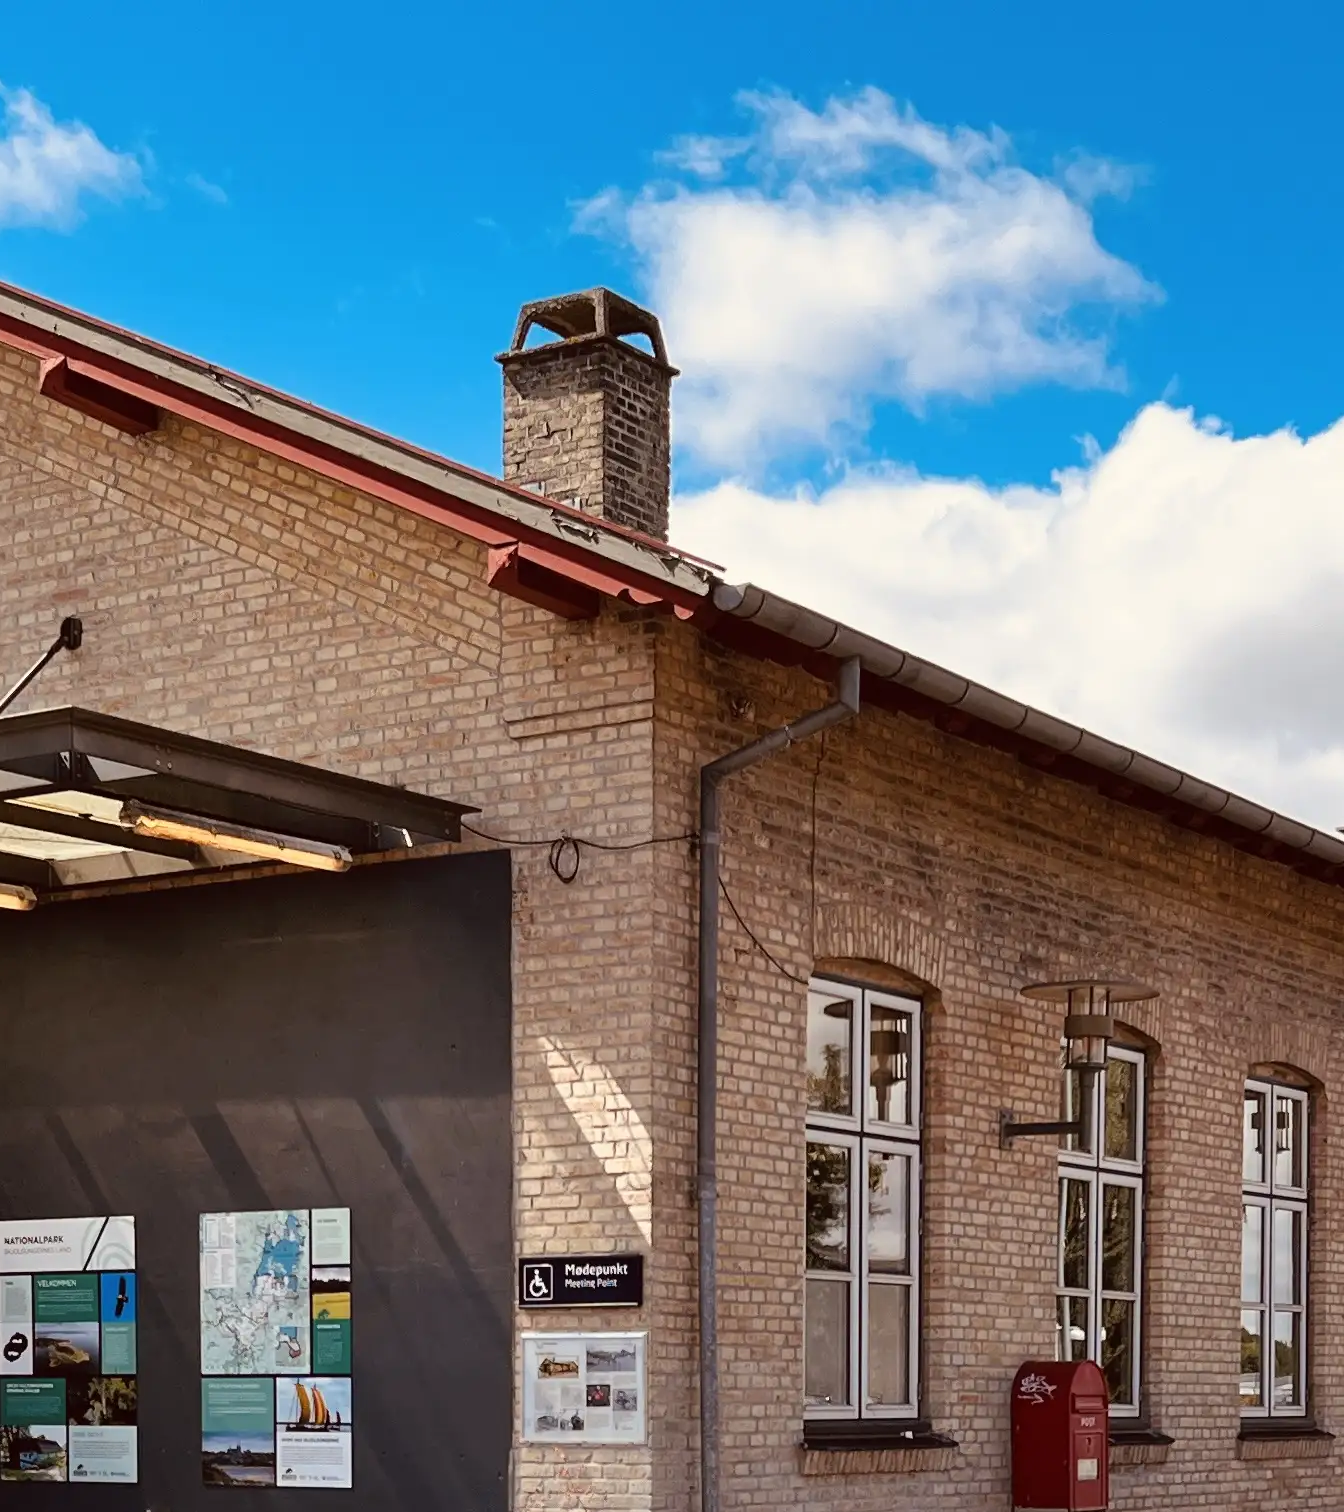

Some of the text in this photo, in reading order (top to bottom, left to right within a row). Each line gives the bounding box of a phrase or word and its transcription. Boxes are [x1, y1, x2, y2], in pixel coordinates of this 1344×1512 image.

[4, 1235, 64, 1246] NATIONALPARK
[564, 1262, 629, 1277] Mødepunkt
[37, 1279, 77, 1288] VELKOMMEN
[564, 1278, 618, 1289] Meeting Point
